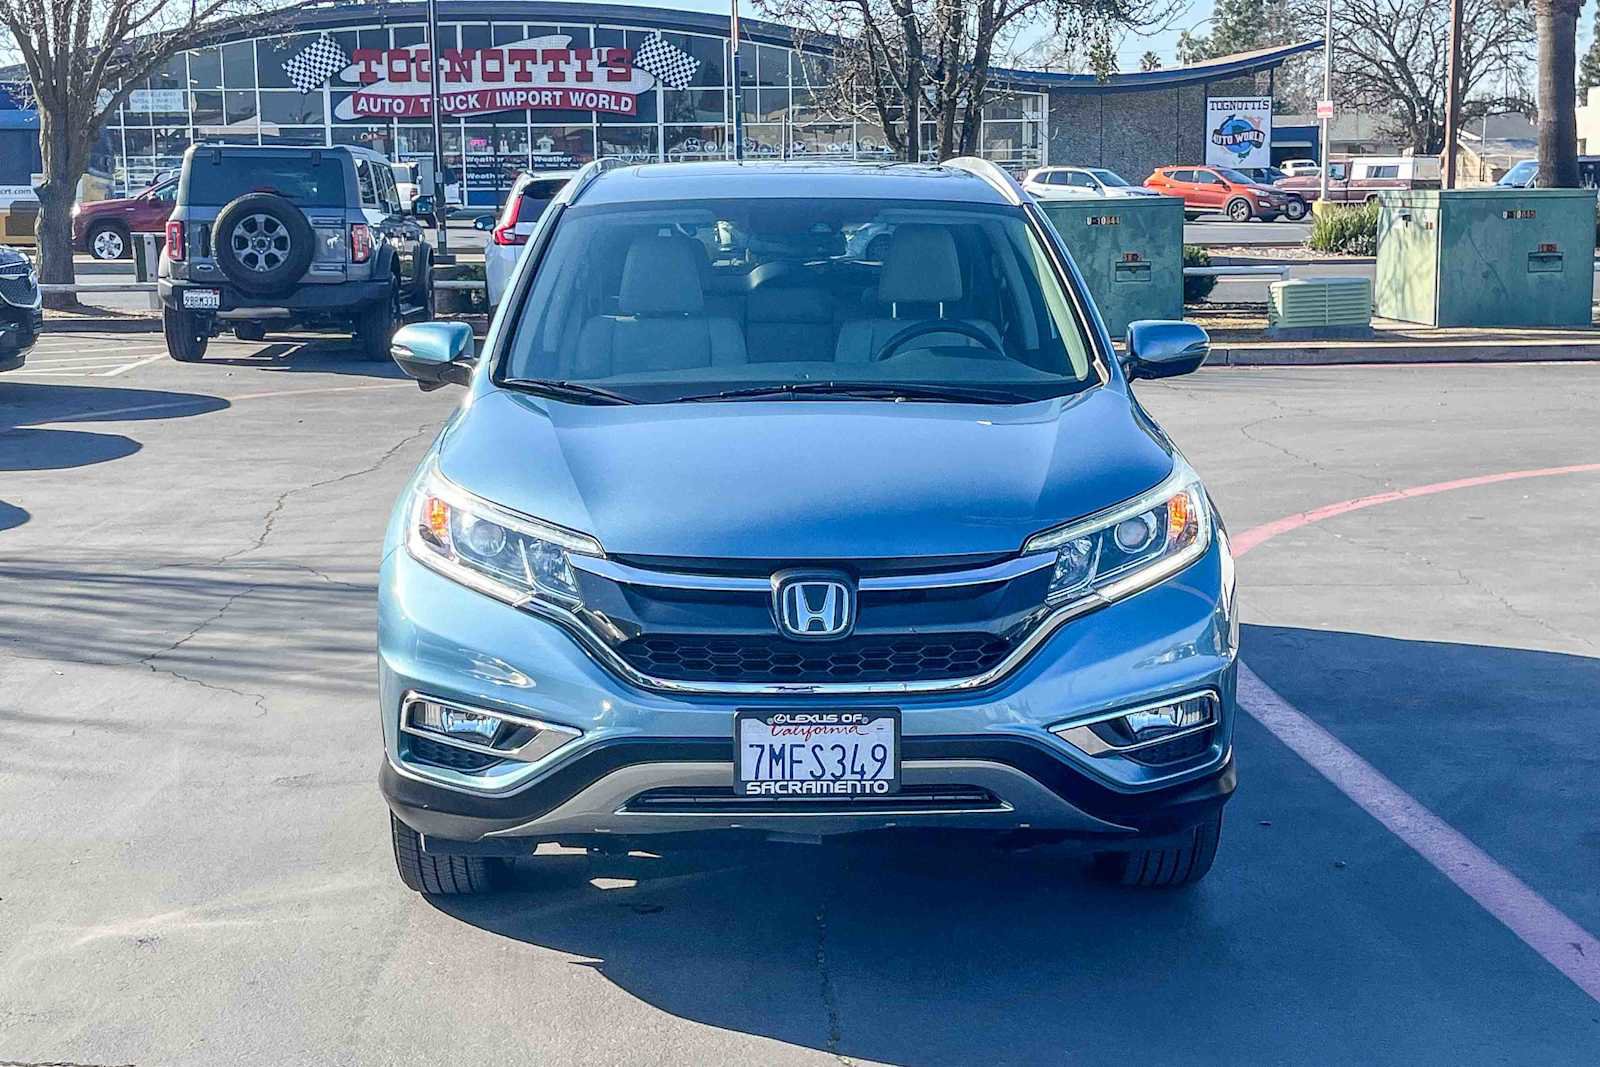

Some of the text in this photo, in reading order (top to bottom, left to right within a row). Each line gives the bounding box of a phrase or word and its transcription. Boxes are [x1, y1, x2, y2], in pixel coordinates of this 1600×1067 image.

[357, 98, 405, 113] AUTO
[420, 93, 480, 113] TUCK
[495, 91, 561, 107] IMPORT
[569, 92, 633, 112] WORLD
[1234, 130, 1264, 144] WORLD
[786, 714, 863, 724] LEXUS OF
[770, 724, 870, 742] California
[749, 743, 888, 780] 7MFS349
[746, 780, 889, 794] SACRAMENTO
